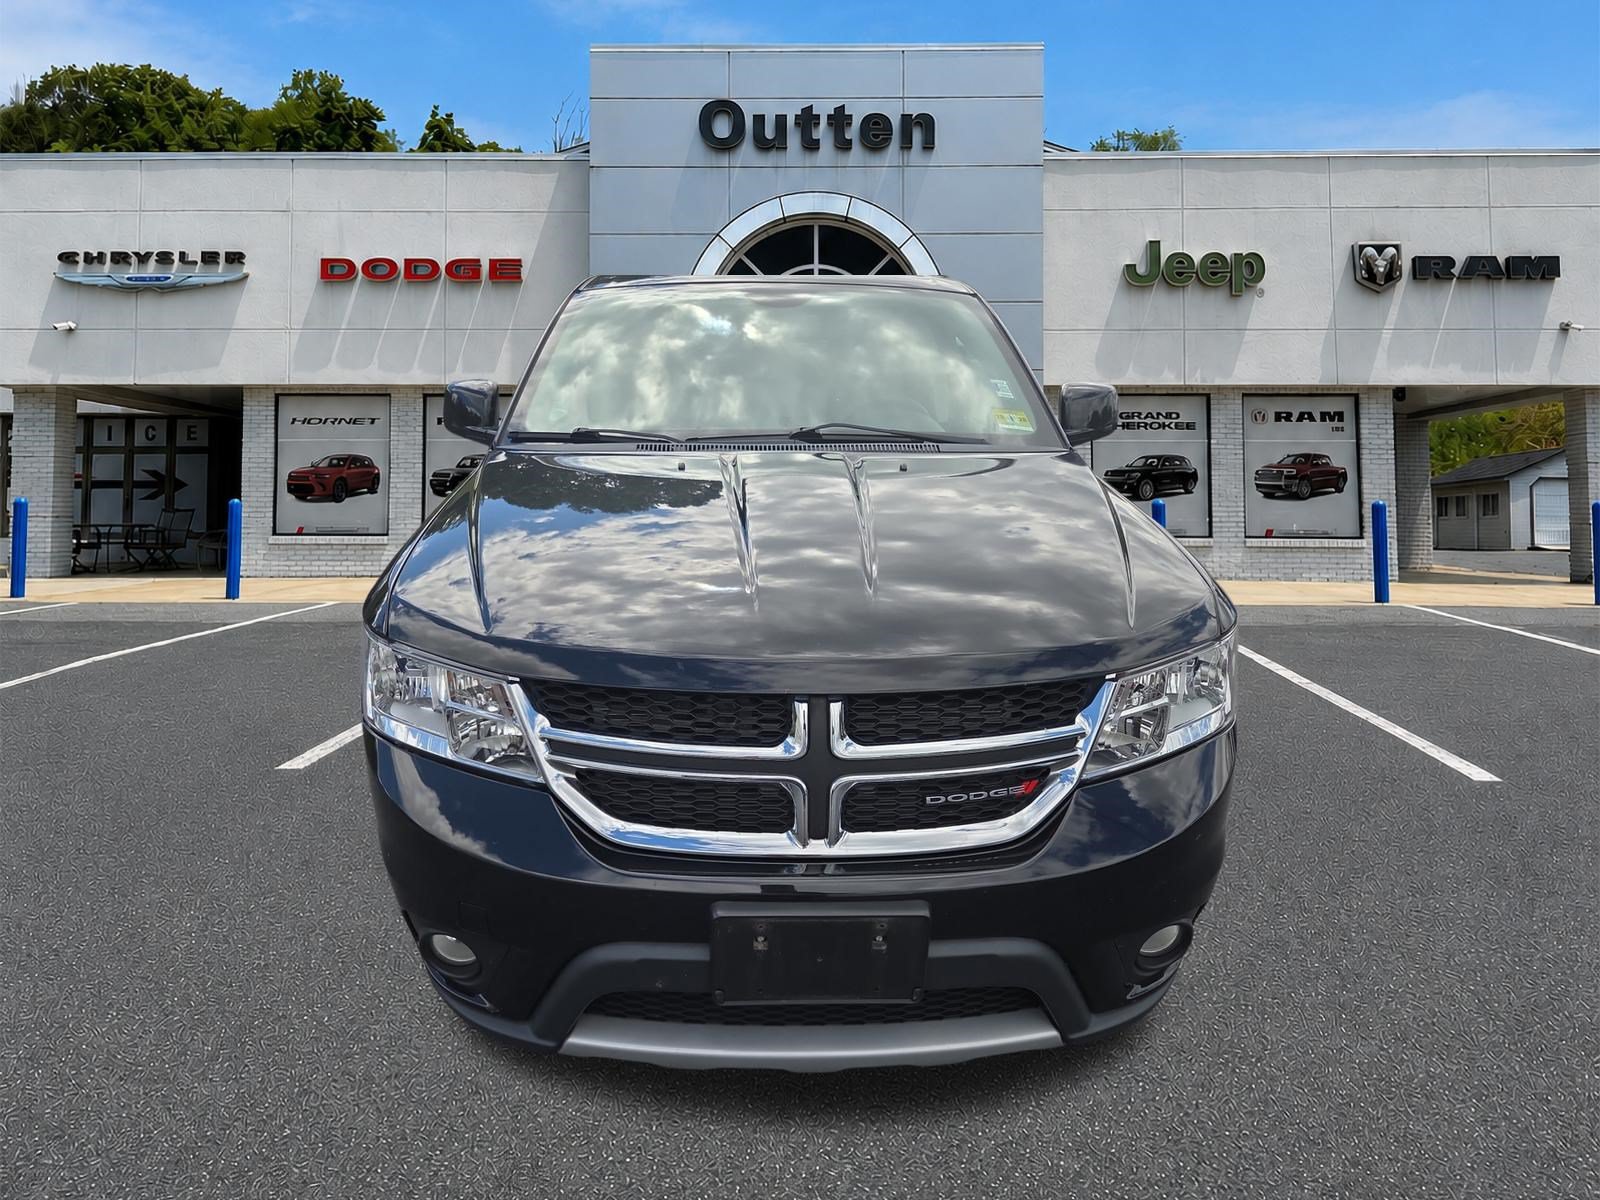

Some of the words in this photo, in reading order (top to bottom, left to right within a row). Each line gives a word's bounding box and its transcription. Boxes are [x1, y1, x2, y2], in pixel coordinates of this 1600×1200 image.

[699, 99, 936, 149] Outten
[57, 250, 246, 266] CHRYSLER
[320, 257, 523, 283] DODGE
[1123, 240, 1266, 296] Jeep
[1412, 255, 1561, 280] RAM
[290, 416, 381, 426] HORNET
[1118, 411, 1180, 420] GRAND
[1274, 411, 1345, 423] RAM
[1115, 421, 1197, 431] HEROKEE
[925, 785, 1025, 805] DODGE
